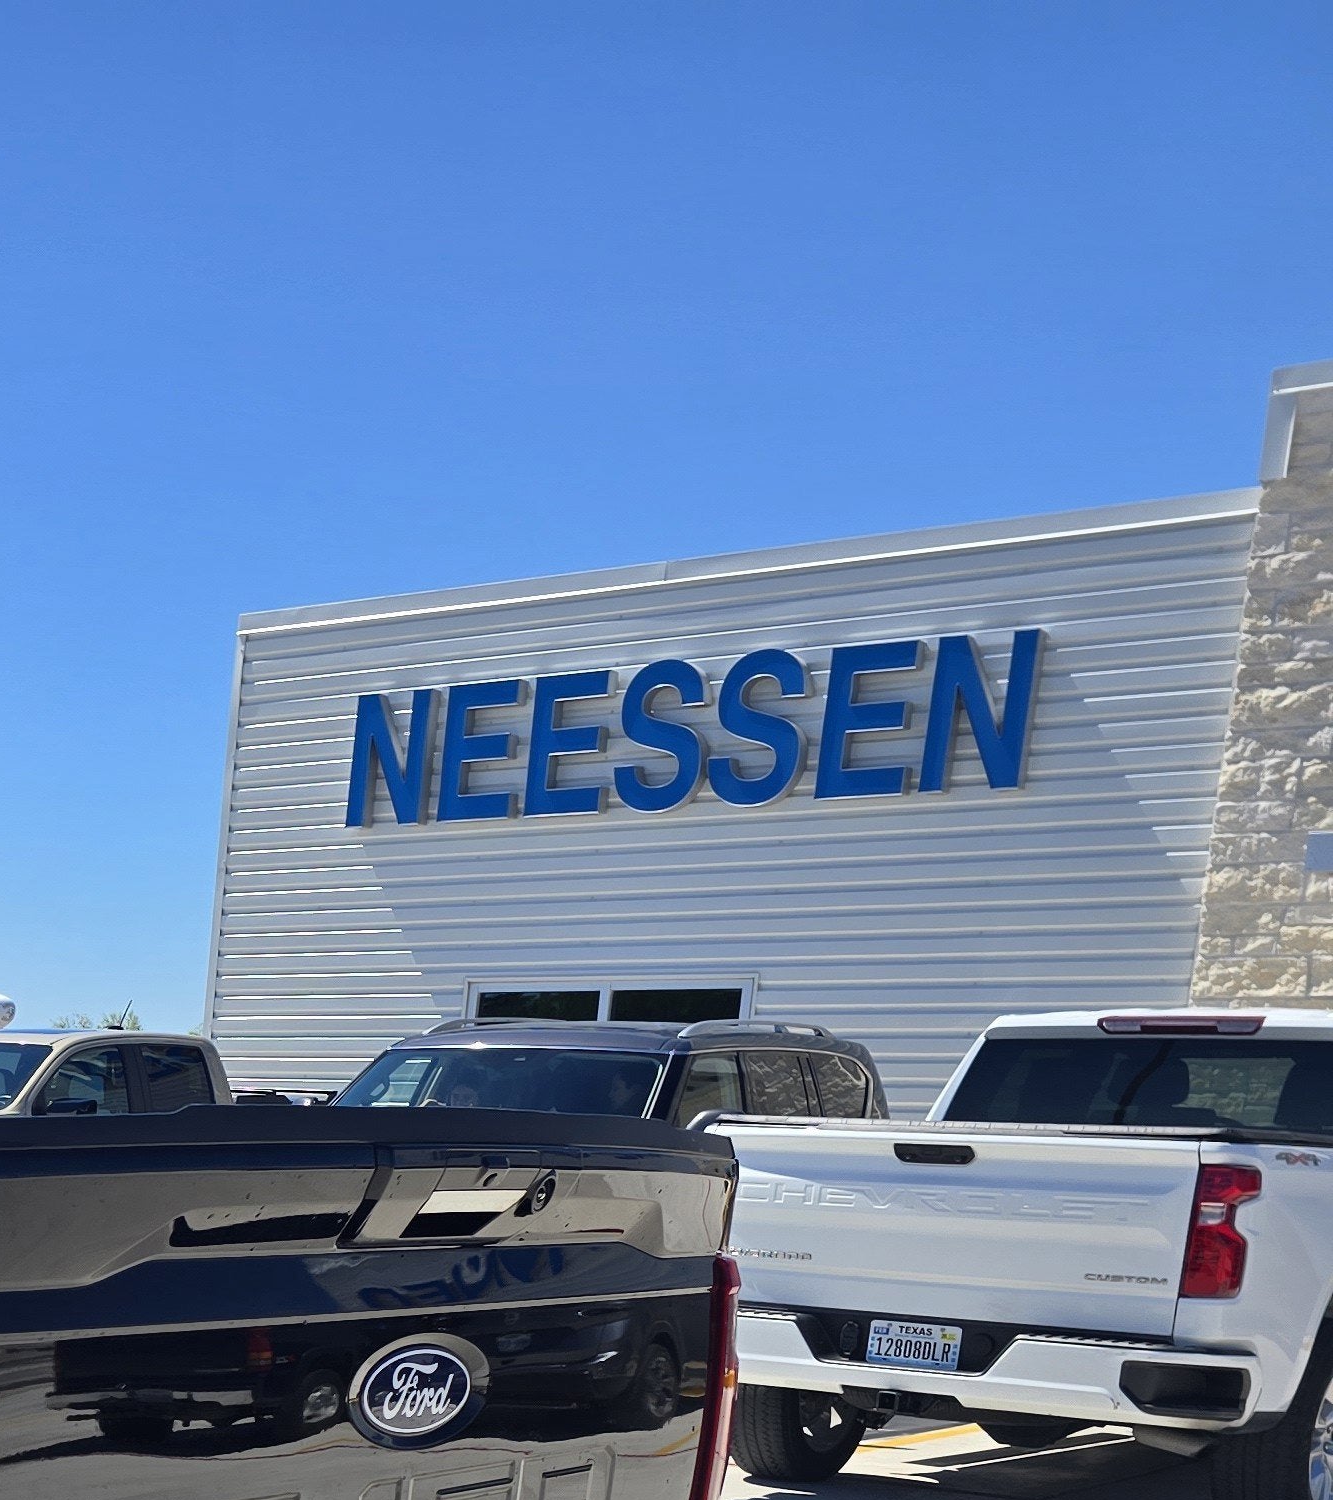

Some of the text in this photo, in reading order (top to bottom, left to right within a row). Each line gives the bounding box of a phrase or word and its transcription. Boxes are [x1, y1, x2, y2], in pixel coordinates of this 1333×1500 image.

[344, 628, 1047, 828] NEESSEN
[1084, 1272, 1169, 1286] CUSTOM
[898, 1325, 933, 1336] TEXAS
[874, 1337, 951, 1363] 12808DLR
[383, 1362, 455, 1420] Ford
